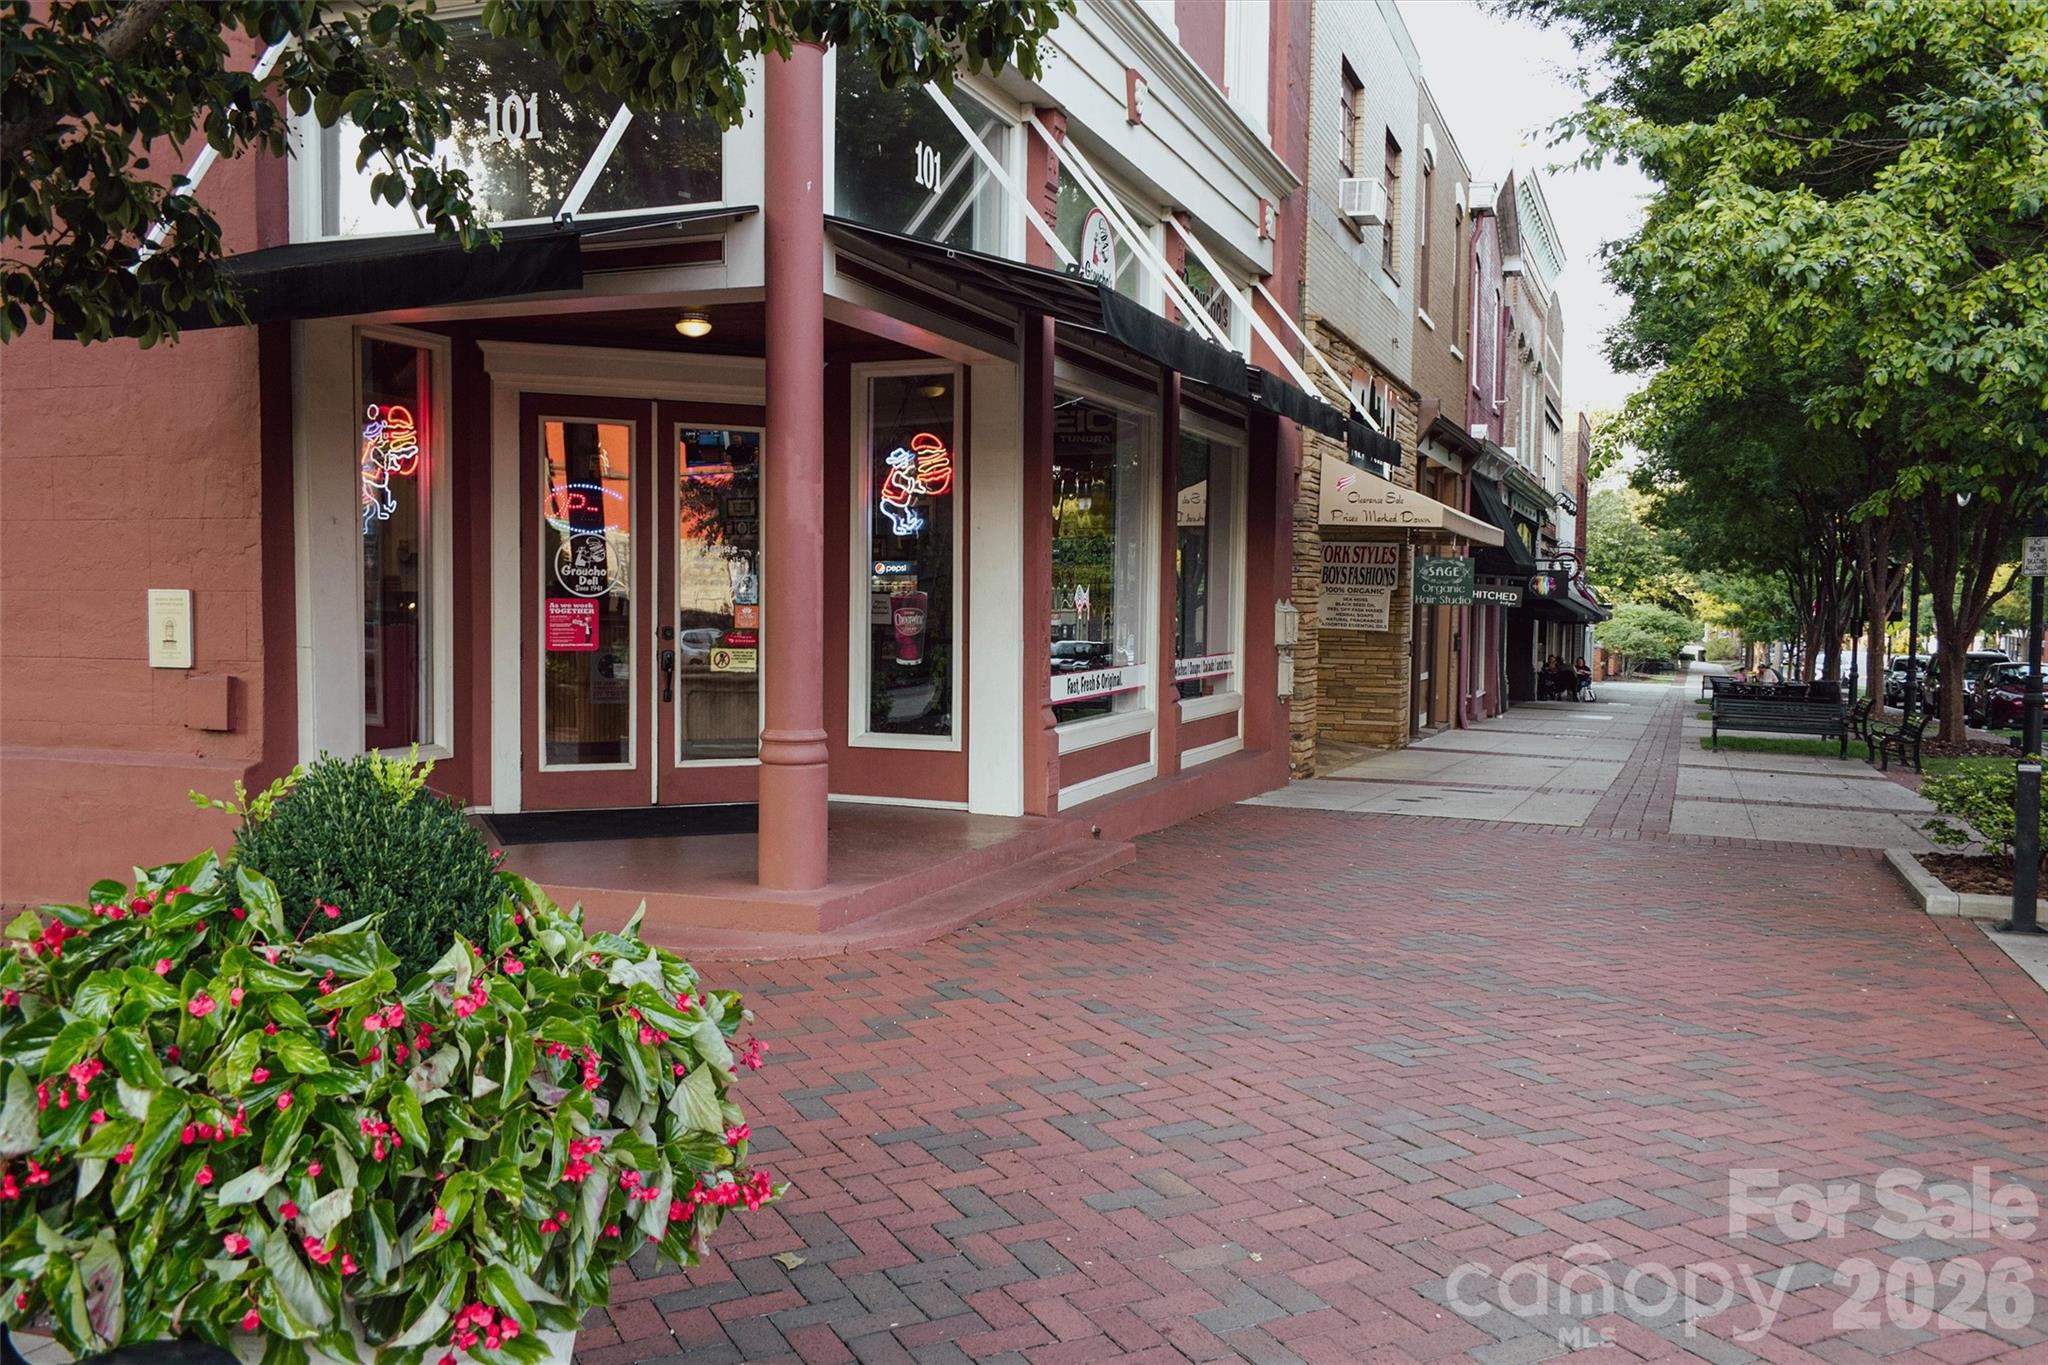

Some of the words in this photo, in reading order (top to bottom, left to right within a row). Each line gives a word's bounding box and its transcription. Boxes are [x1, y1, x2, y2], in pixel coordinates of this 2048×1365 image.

[484, 92, 543, 144] 101
[915, 140, 942, 194] 101
[1385, 491, 1404, 505] Sale
[1331, 509, 1358, 523] Prices
[1364, 510, 1397, 523] Marked
[1400, 510, 1431, 523] Down
[1352, 545, 1397, 565] STYLES
[885, 564, 907, 573] pepsi
[1428, 566, 1460, 577] SAGE
[579, 576, 599, 586] Deli
[1322, 566, 1347, 585] BOYS
[1347, 566, 1396, 587] FASHIONS
[1347, 587, 1384, 595] ORGANIC
[1421, 583, 1466, 595] Organic
[1415, 595, 1436, 605] Hair
[1439, 594, 1472, 605] Studio
[1066, 678, 1080, 695] Fast,
[1080, 676, 1096, 692] Fresh
